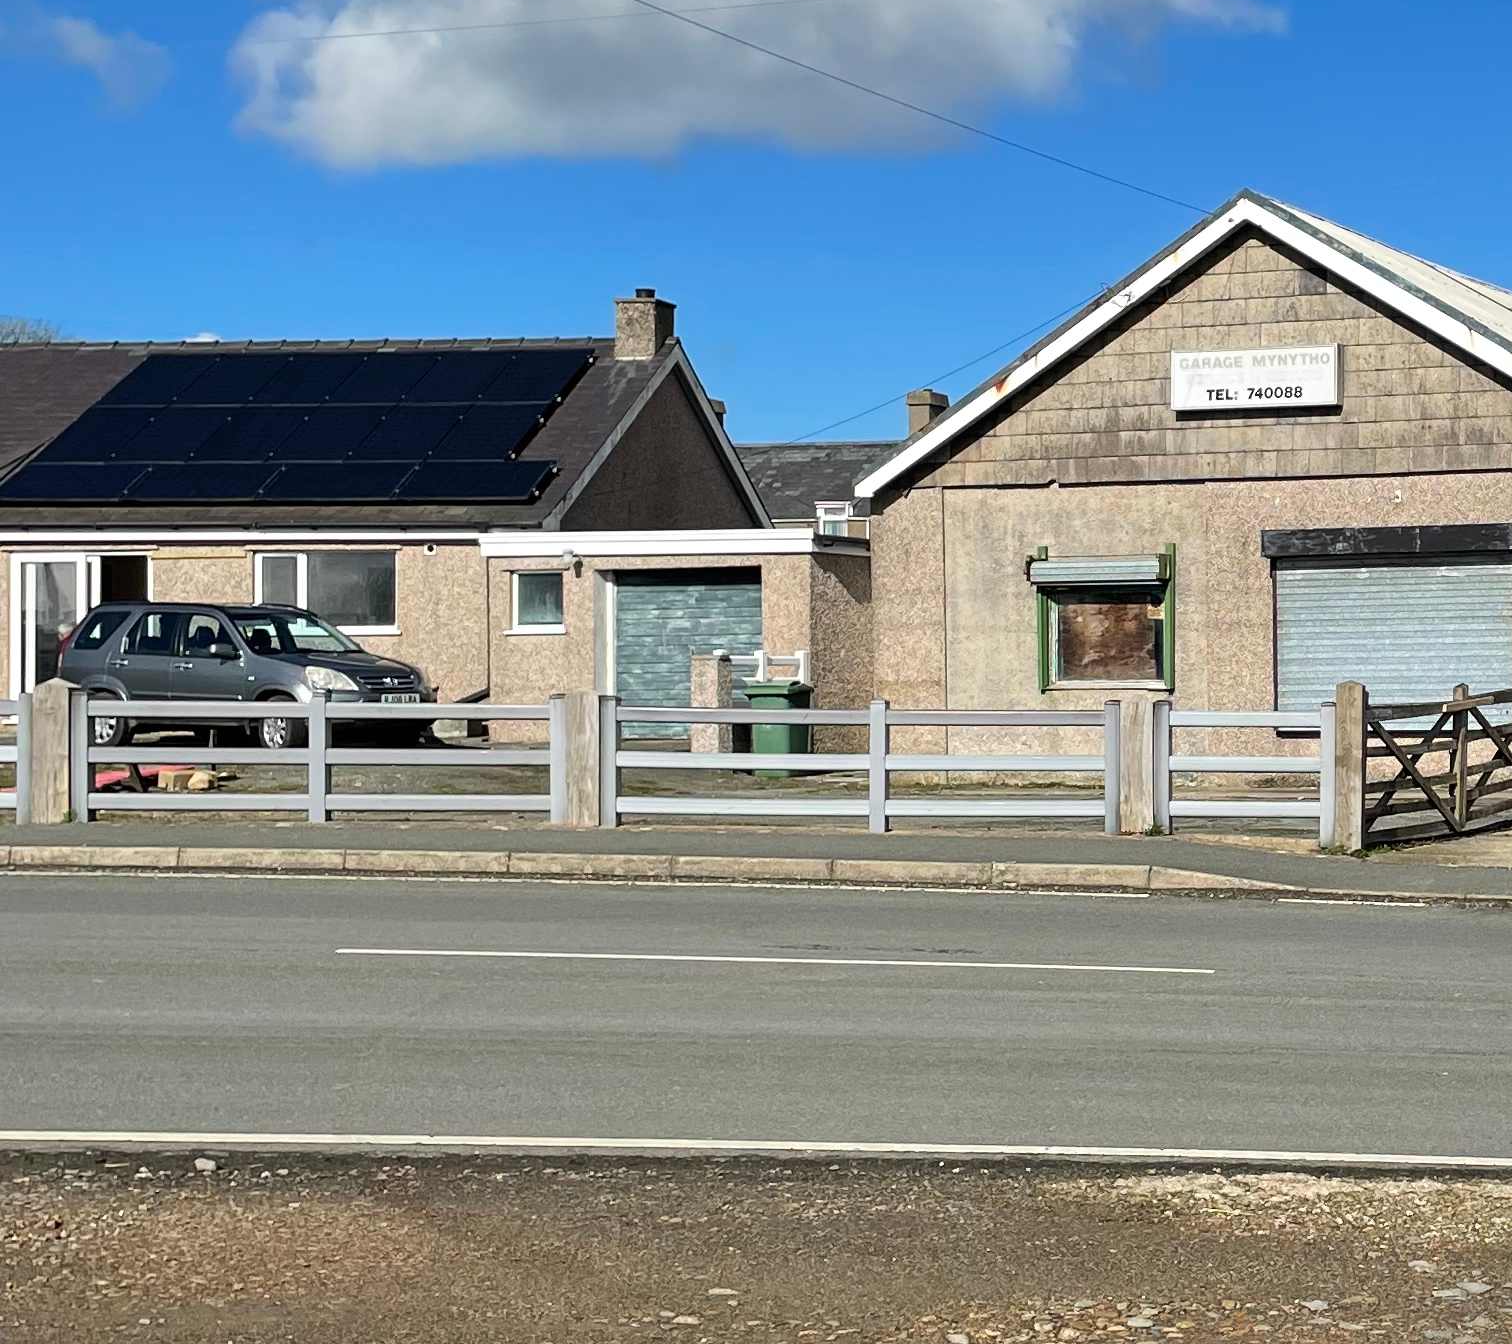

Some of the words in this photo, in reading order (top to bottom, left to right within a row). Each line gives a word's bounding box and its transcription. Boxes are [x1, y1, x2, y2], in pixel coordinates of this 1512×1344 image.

[1179, 356, 1243, 370] GARAGE
[1252, 353, 1330, 368] MYNYTHO
[1206, 388, 1238, 401] TEL:
[1247, 386, 1303, 400] 740088
